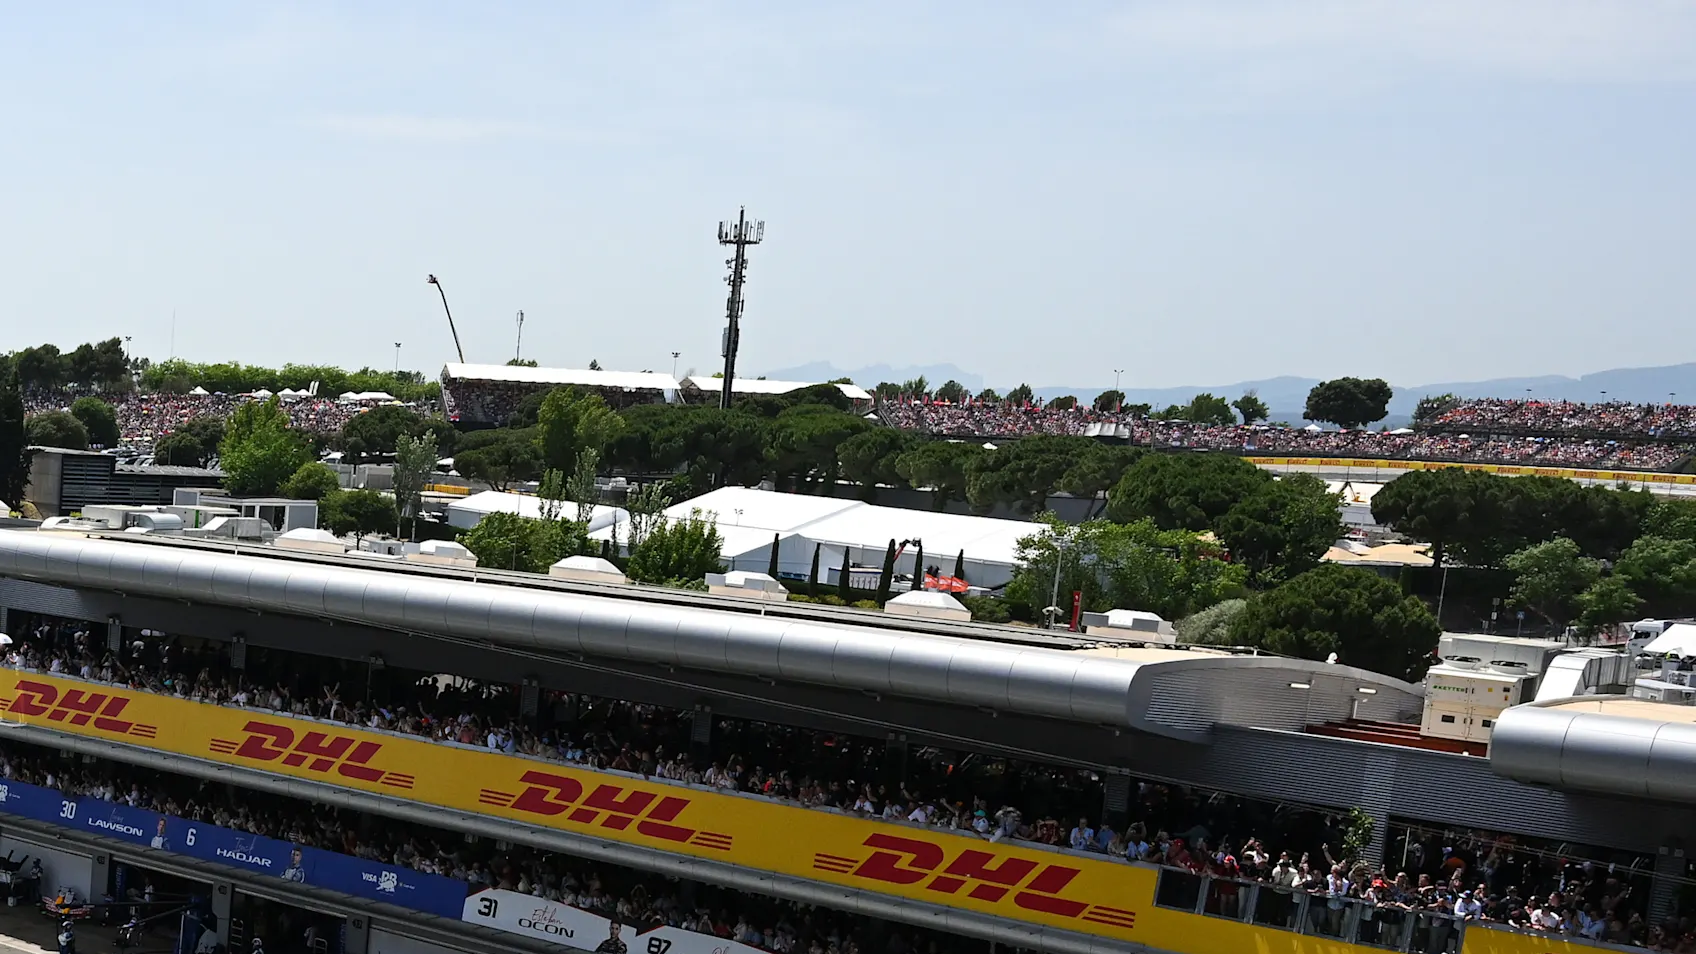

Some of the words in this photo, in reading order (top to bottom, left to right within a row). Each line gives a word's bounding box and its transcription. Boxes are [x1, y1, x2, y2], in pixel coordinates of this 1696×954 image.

[8, 680, 133, 734] DHL
[234, 720, 386, 782] DHL
[60, 800, 77, 820] 30
[511, 770, 696, 842] DHL
[88, 817, 144, 837] LAWSON
[186, 828, 196, 846] 6
[216, 848, 272, 868] HADJAR
[361, 872, 378, 884] VISA
[852, 832, 1090, 918] DHL
[478, 897, 498, 918] 31
[532, 906, 564, 925] Esteban
[518, 918, 574, 938] OCON
